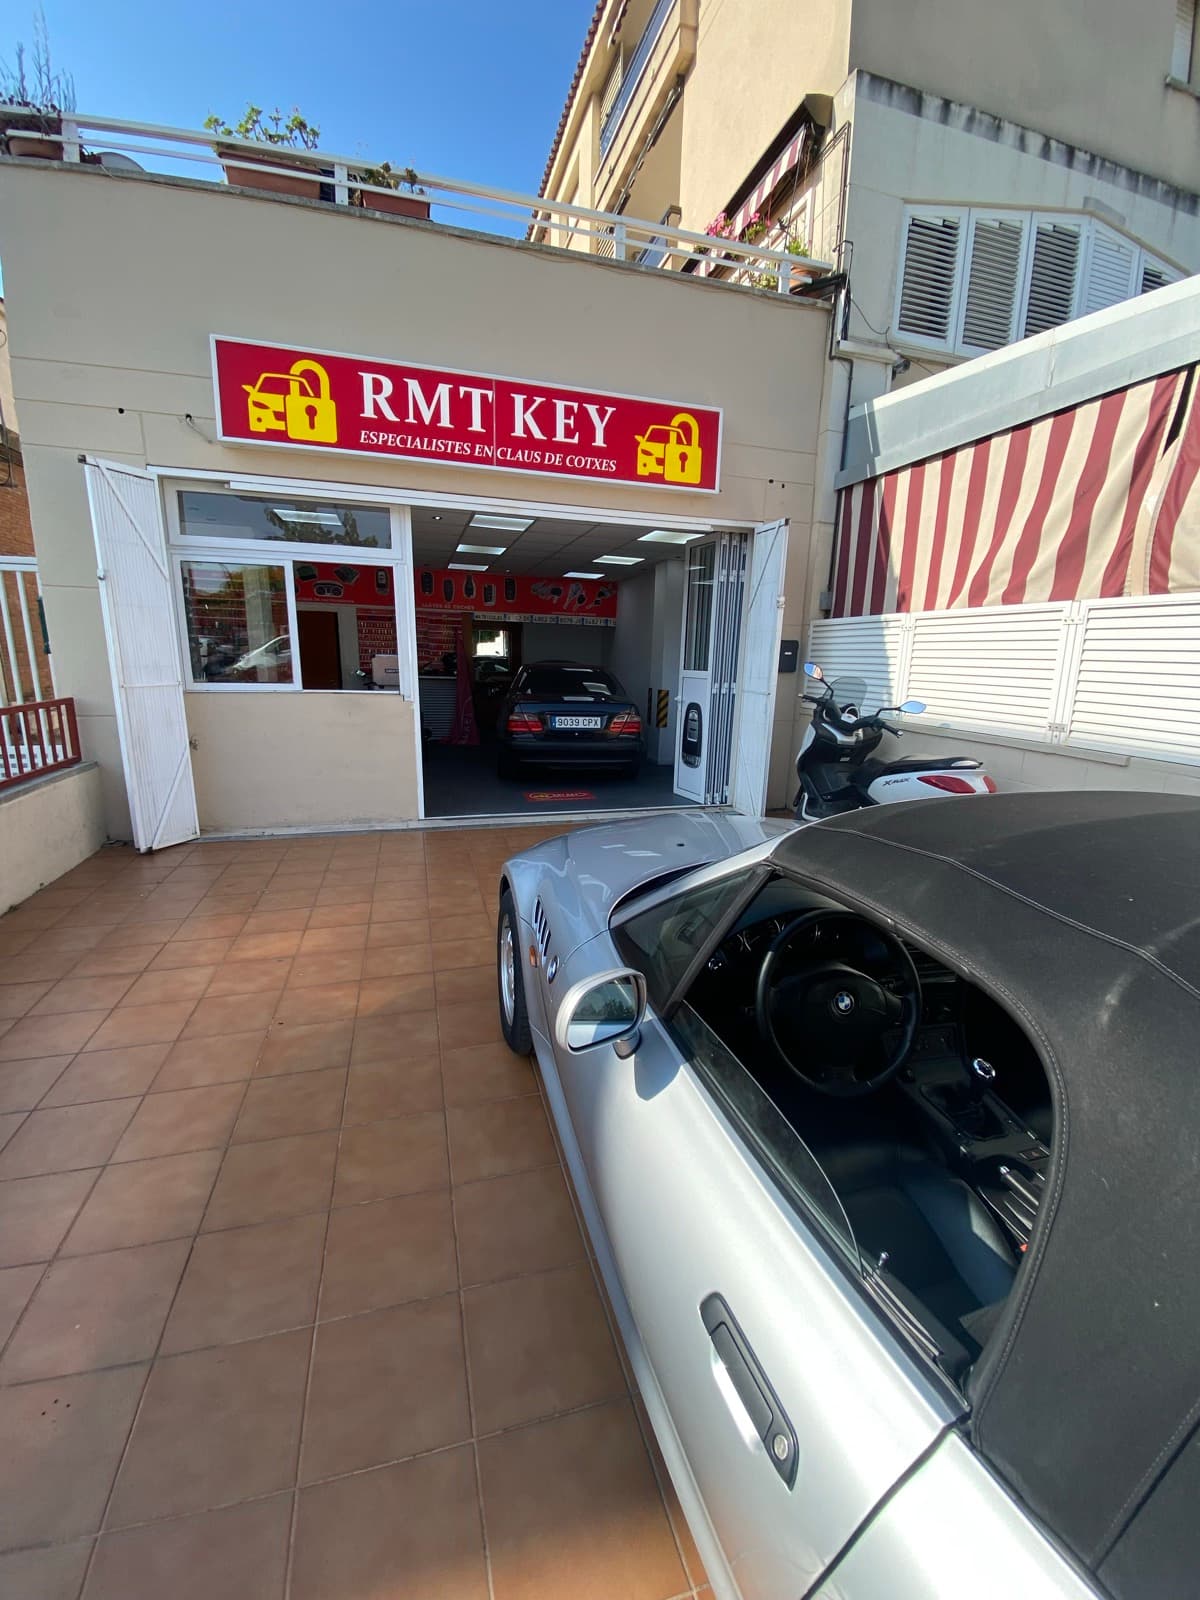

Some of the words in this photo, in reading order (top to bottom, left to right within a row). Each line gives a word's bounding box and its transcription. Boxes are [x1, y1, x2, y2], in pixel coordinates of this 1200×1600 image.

[358, 371, 494, 433] RMT
[510, 393, 617, 448] KEY
[359, 430, 472, 455] ESPECIALISTES
[474, 444, 494, 458] EN
[496, 447, 542, 464] CLAUS
[544, 452, 564, 466] DE
[565, 455, 617, 472] COTXES
[557, 717, 580, 728] 9039
[582, 718, 599, 728] CPX
